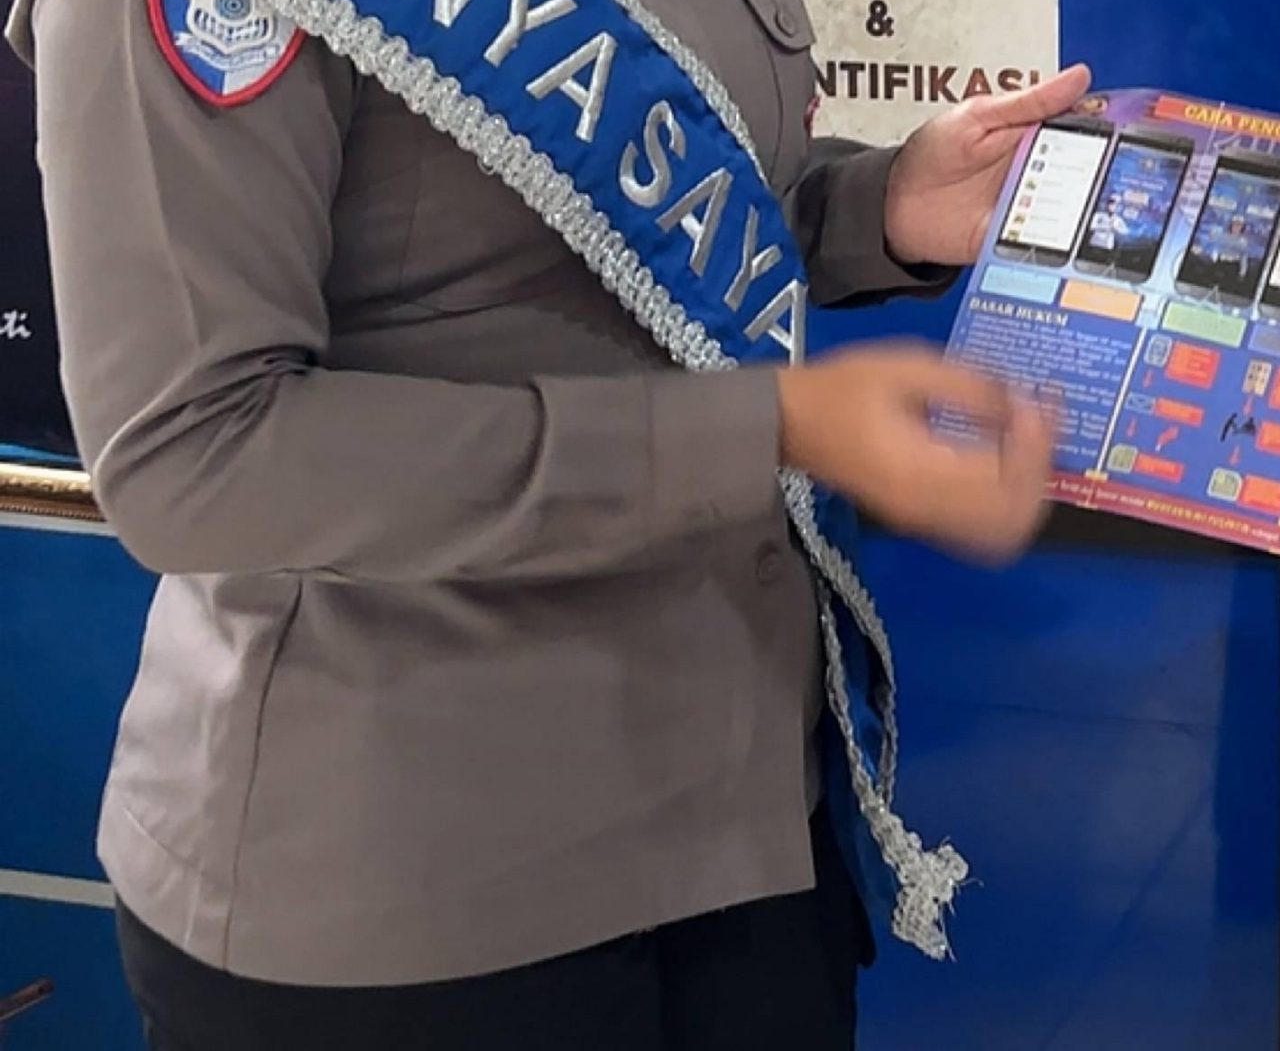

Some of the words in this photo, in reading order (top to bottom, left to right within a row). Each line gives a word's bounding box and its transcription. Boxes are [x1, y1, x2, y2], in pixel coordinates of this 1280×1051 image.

[866, 0, 895, 37] &
[1184, 103, 1233, 128] CARA
[619, 100, 809, 366] SAYA
[1016, 305, 1069, 327] HUKUM
